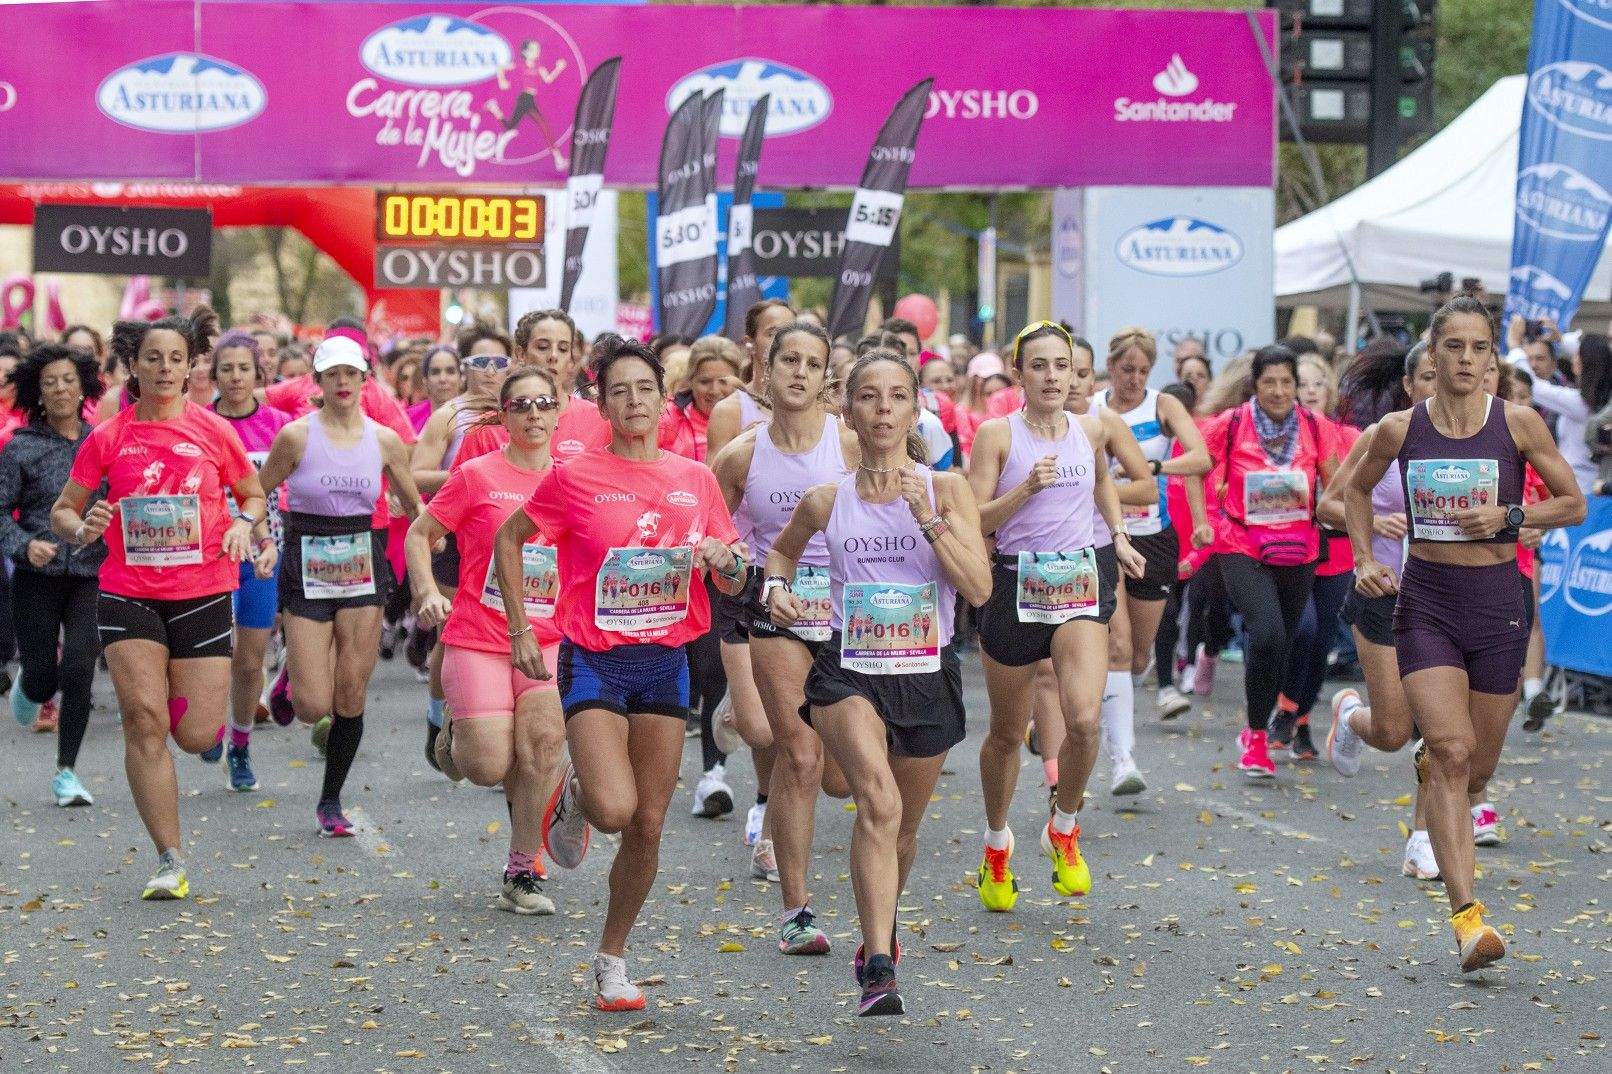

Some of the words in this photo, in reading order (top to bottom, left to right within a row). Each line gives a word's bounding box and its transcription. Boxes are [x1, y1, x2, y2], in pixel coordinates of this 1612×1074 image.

[113, 83, 250, 112] ASTURIANA
[346, 78, 473, 119] Carrera
[1113, 97, 1237, 122] Santander
[417, 113, 518, 176] Mujer
[60, 224, 189, 258] OYSHO
[753, 230, 846, 259] OYSH
[382, 249, 542, 285] OYSHO
[1056, 465, 1087, 479] SHO
[321, 475, 371, 489] OYSHO
[489, 491, 524, 501] OYSHO
[595, 493, 636, 503] OYSHO
[770, 490, 804, 504] OYS
[1435, 496, 1469, 509] 016
[148, 526, 176, 538] 016
[844, 535, 917, 554] OYSHO
[629, 581, 661, 598] 016
[1046, 583, 1074, 597] 016
[607, 618, 637, 626] OYSHO
[873, 622, 910, 638] 016
[852, 661, 883, 669] OYSHO
